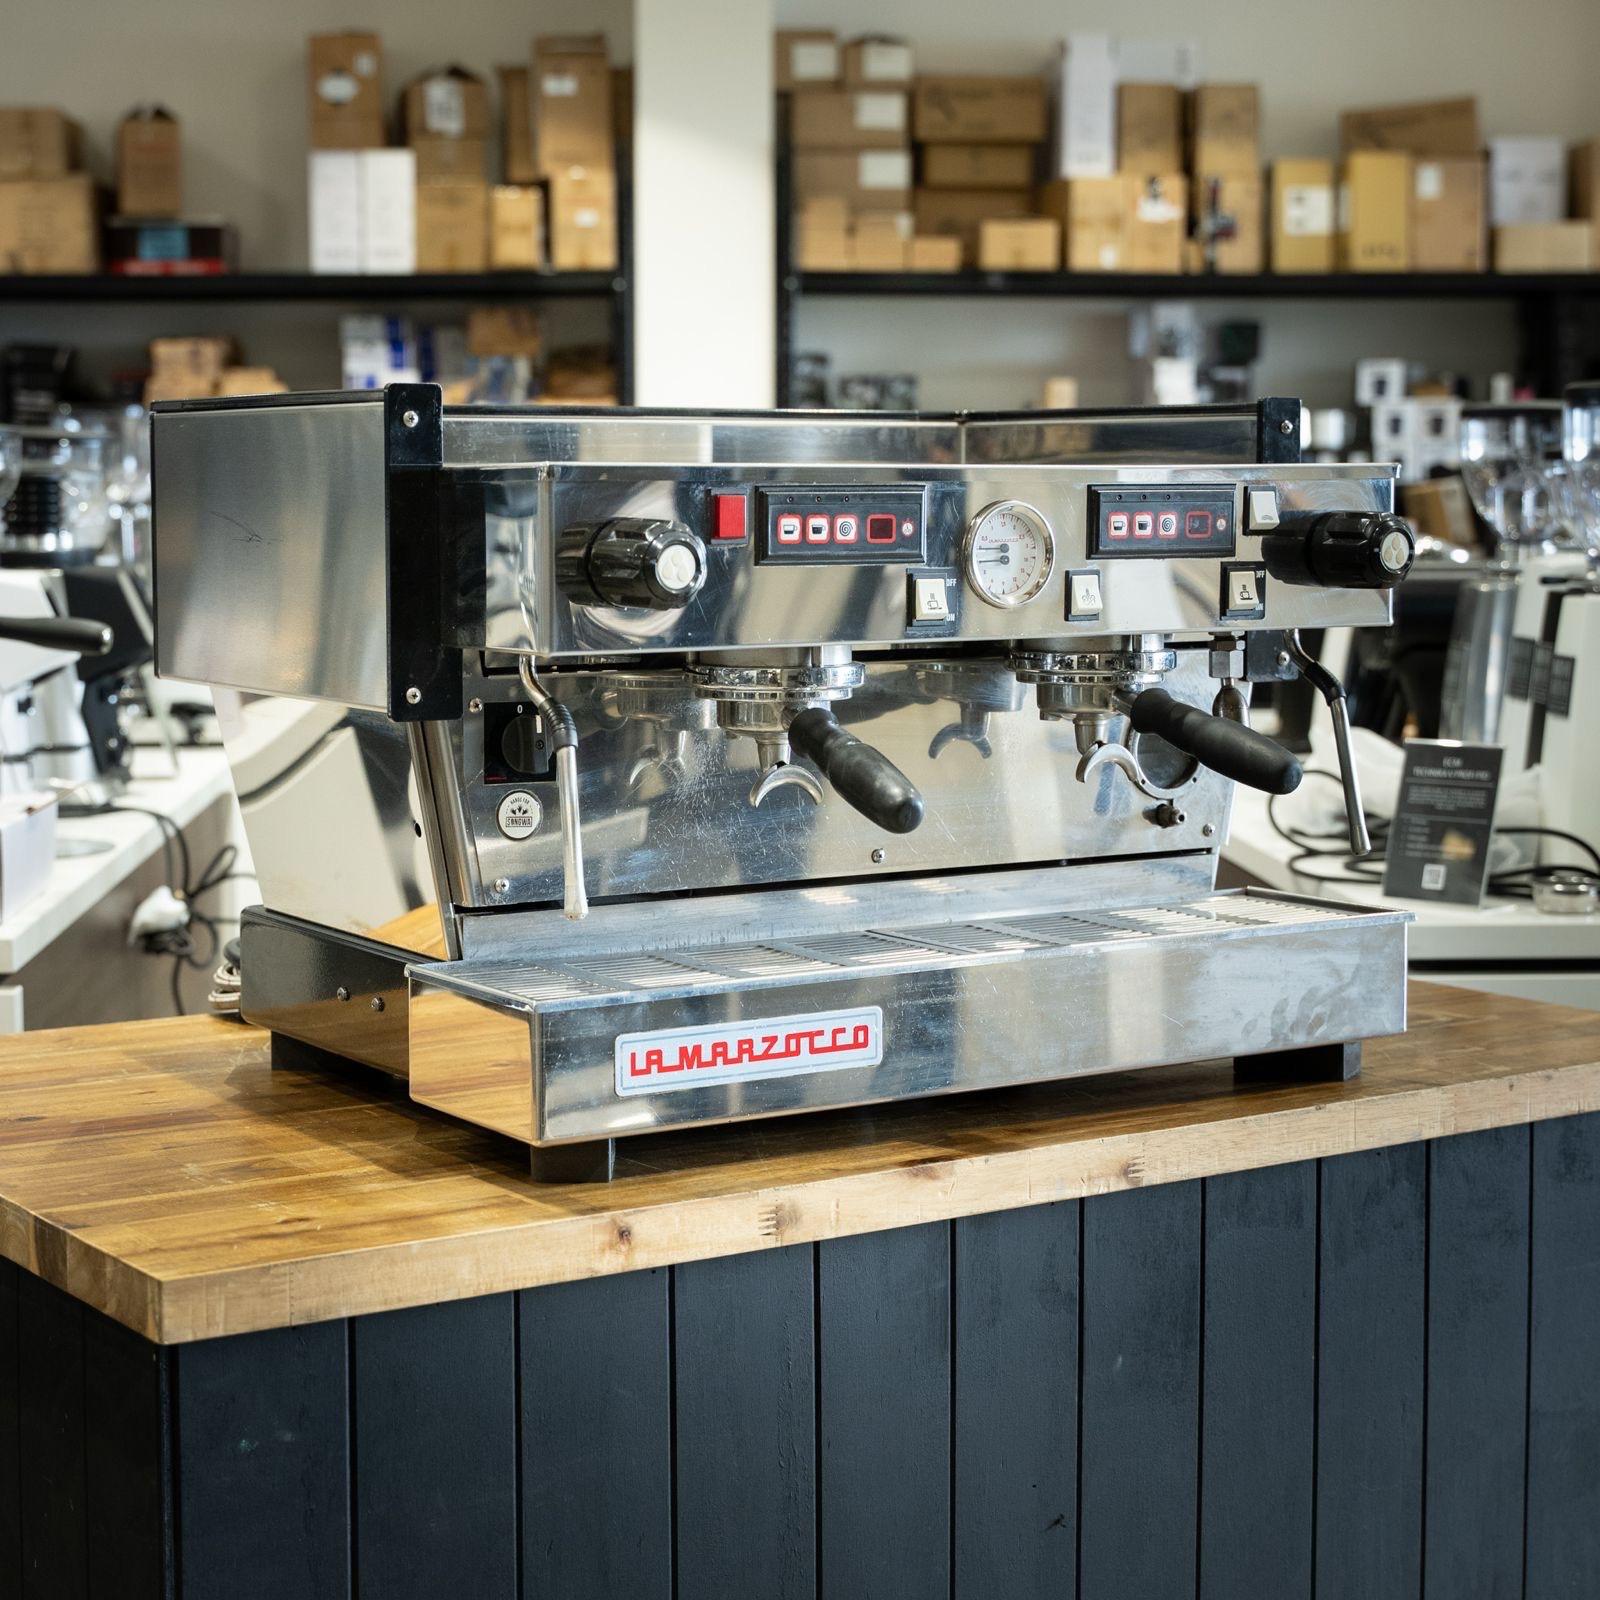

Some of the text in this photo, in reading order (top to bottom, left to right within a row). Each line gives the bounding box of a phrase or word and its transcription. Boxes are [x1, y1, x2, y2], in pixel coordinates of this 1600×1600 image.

[946, 578, 957, 587] OFF
[946, 613, 956, 621] ON
[507, 818, 530, 826] SONGWA
[630, 1024, 869, 1077] LA MARZOCCO
